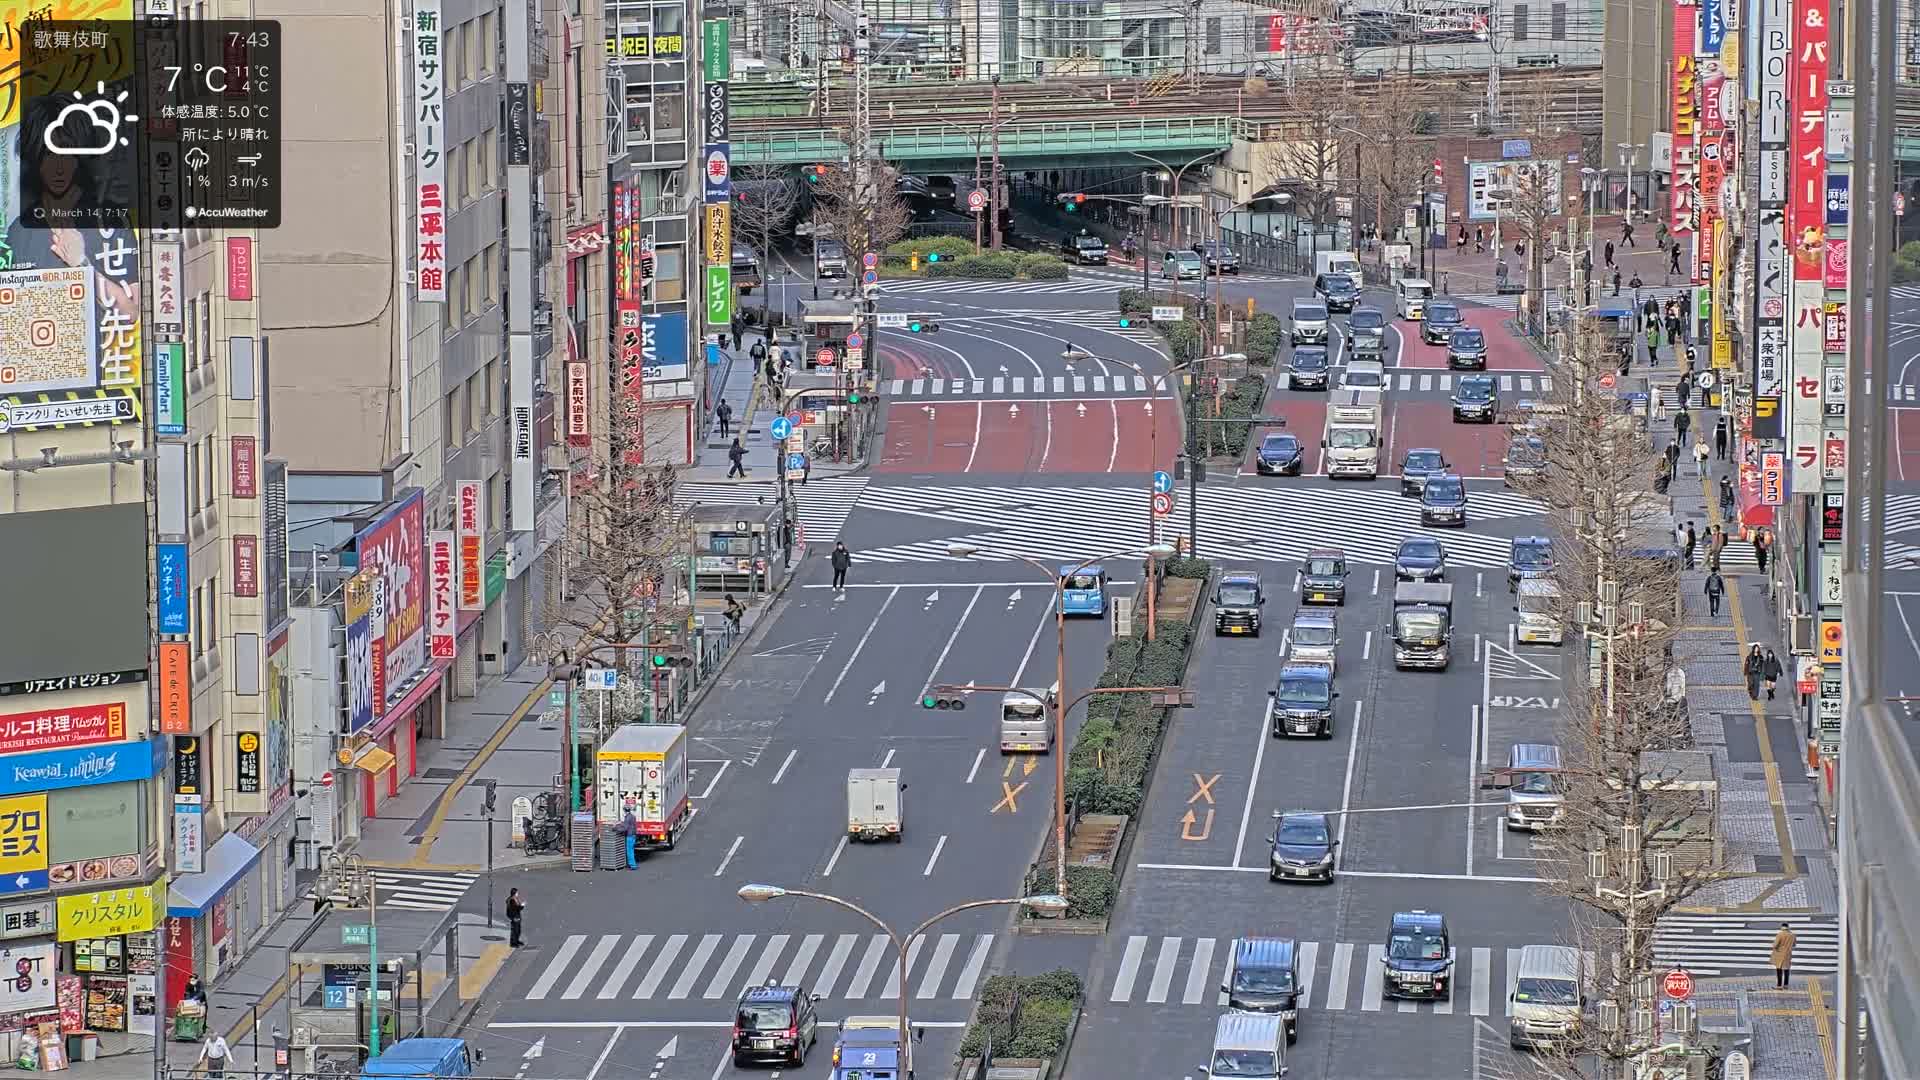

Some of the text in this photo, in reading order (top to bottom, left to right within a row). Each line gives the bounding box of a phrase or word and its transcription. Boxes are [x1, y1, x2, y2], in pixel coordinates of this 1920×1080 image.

[1709, 0, 1720, 44] ントラル
[654, 36, 682, 54] 夜間
[1677, 56, 1694, 134] パチンコ
[1707, 87, 1719, 119] アコム
[417, 10, 443, 291] 新宿サンパーク 三平本館
[1674, 148, 1693, 231] エスパス
[712, 208, 724, 262] 肉汁水餃子
[711, 275, 725, 312] レイク
[159, 323, 176, 332] 3F
[1761, 329, 1775, 381] 大衆酒場
[159, 352, 170, 414] FamilyMart
[1796, 307, 1822, 468] パセラ
[15, 406, 113, 420] テンクリ たいせい先生
[516, 407, 528, 459] HOMEGAME
[462, 486, 475, 530] GAME
[433, 542, 450, 629] 三平ストア
[25, 673, 121, 693] リアエイド ビジョン
[26, 735, 70, 747] RESTAURANT
[167, 720, 183, 730] B2
[1, 810, 40, 831] プロ
[2, 836, 41, 857] ミス
[6, 911, 40, 931] 囲碁
[71, 902, 143, 927] クリスタル
[328, 989, 344, 1004] 12
